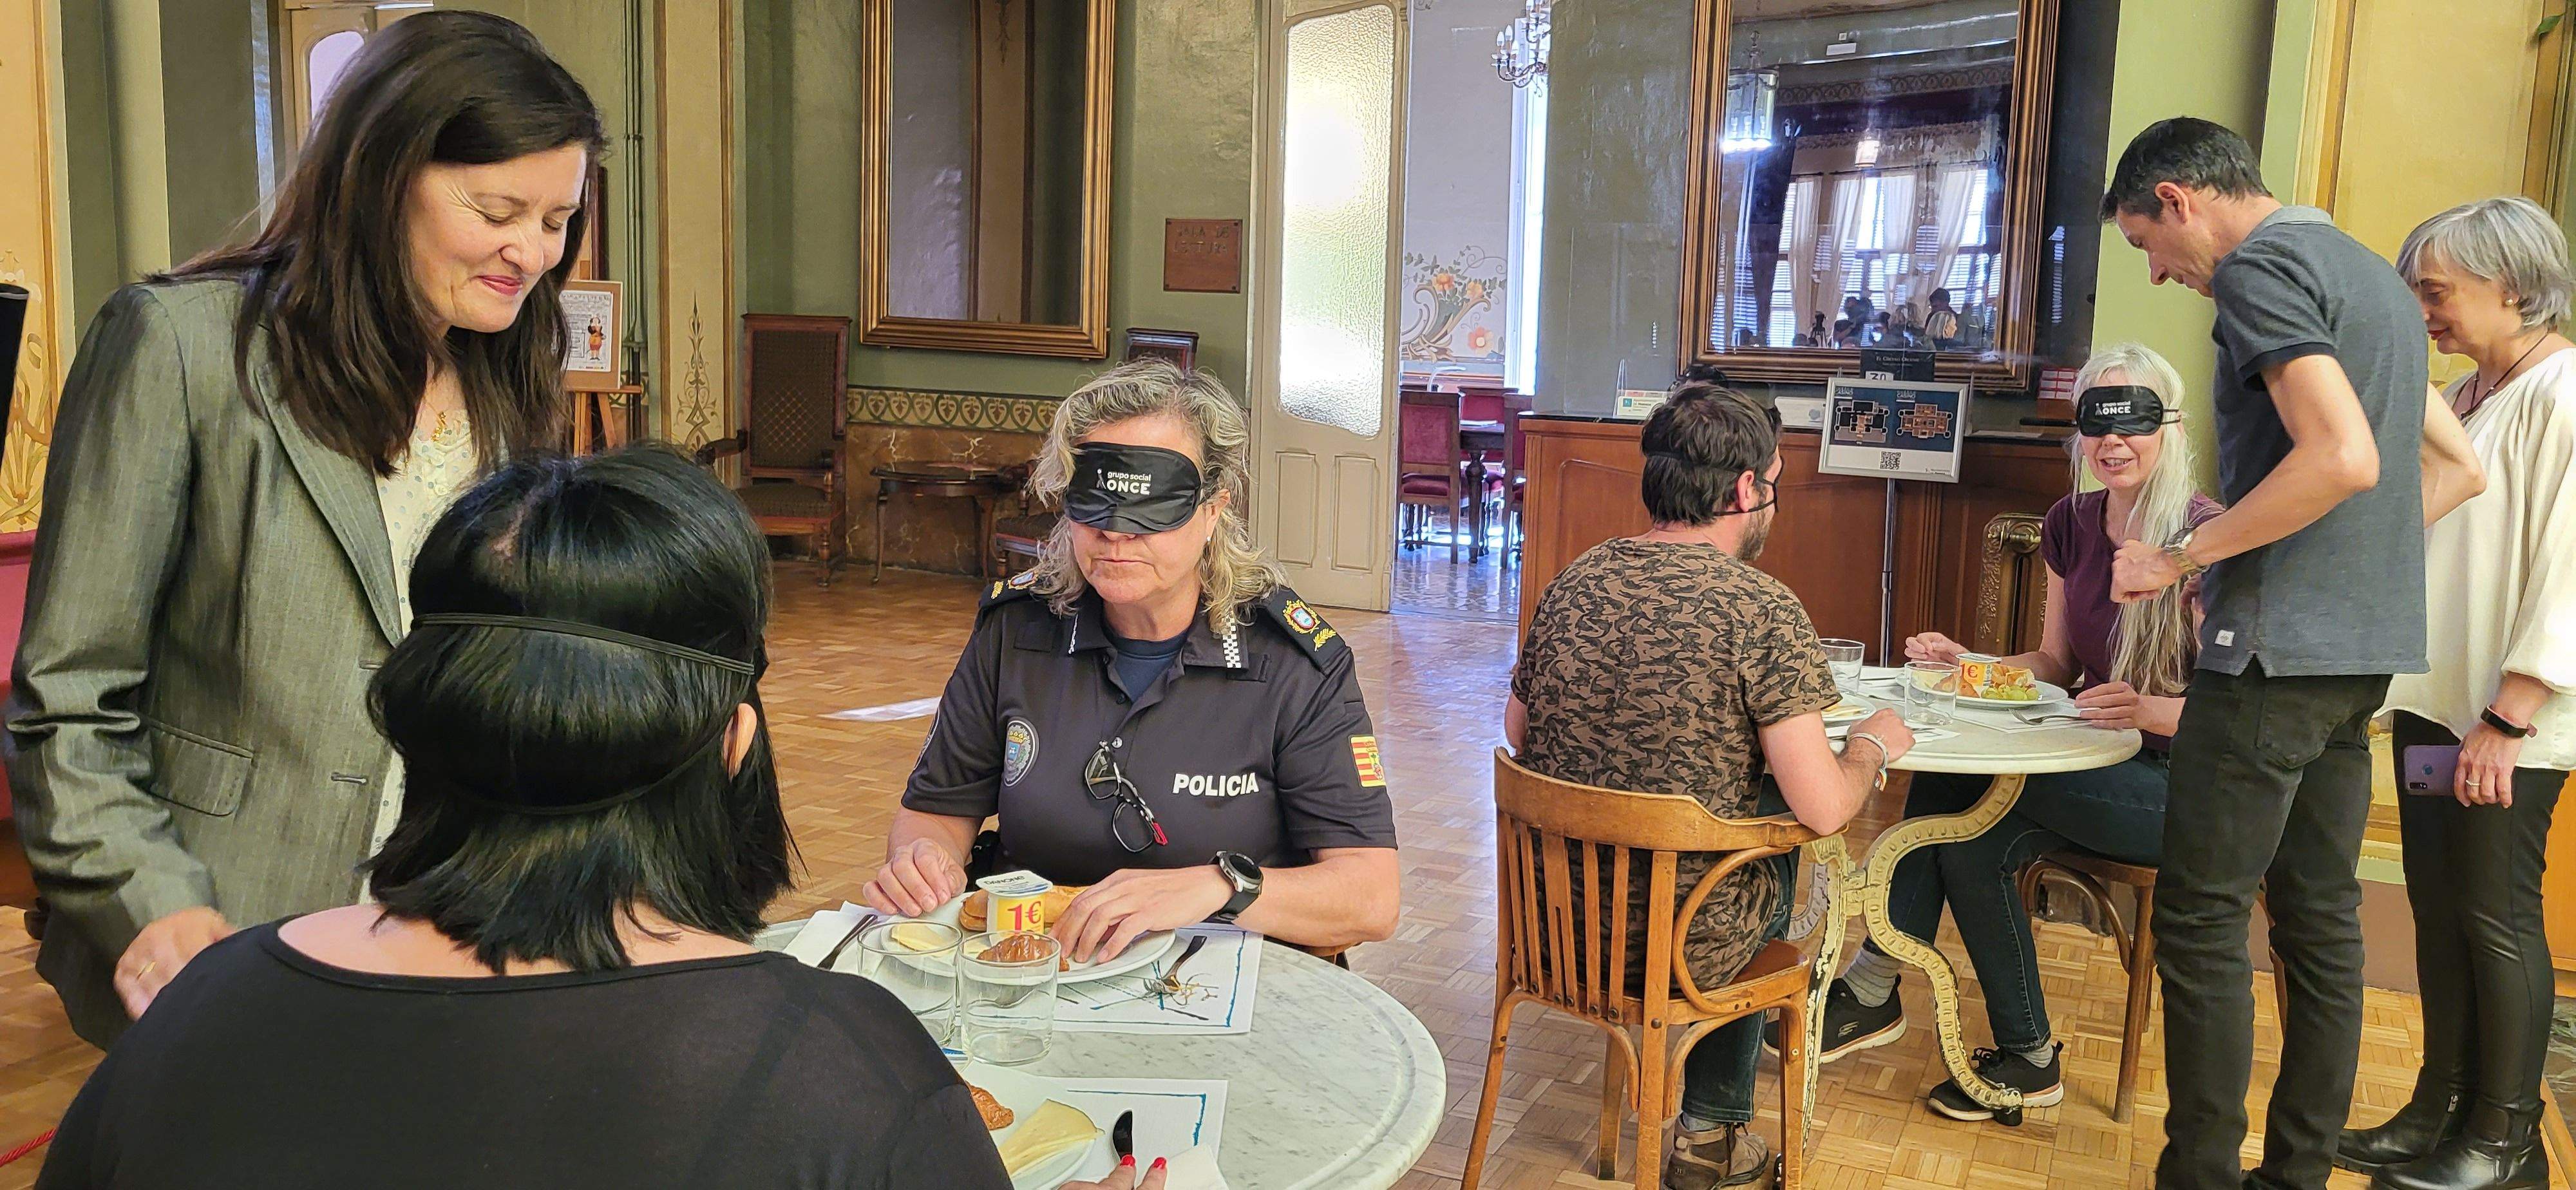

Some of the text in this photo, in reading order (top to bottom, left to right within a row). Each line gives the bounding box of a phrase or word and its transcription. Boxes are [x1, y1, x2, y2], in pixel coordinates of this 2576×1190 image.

[2103, 406, 2131, 415] ONCE
[1107, 471, 1151, 482] grupo social
[1106, 480, 1151, 495] ONCE
[1172, 772, 1260, 797] POLICIA
[1007, 901, 1041, 934] 1€
